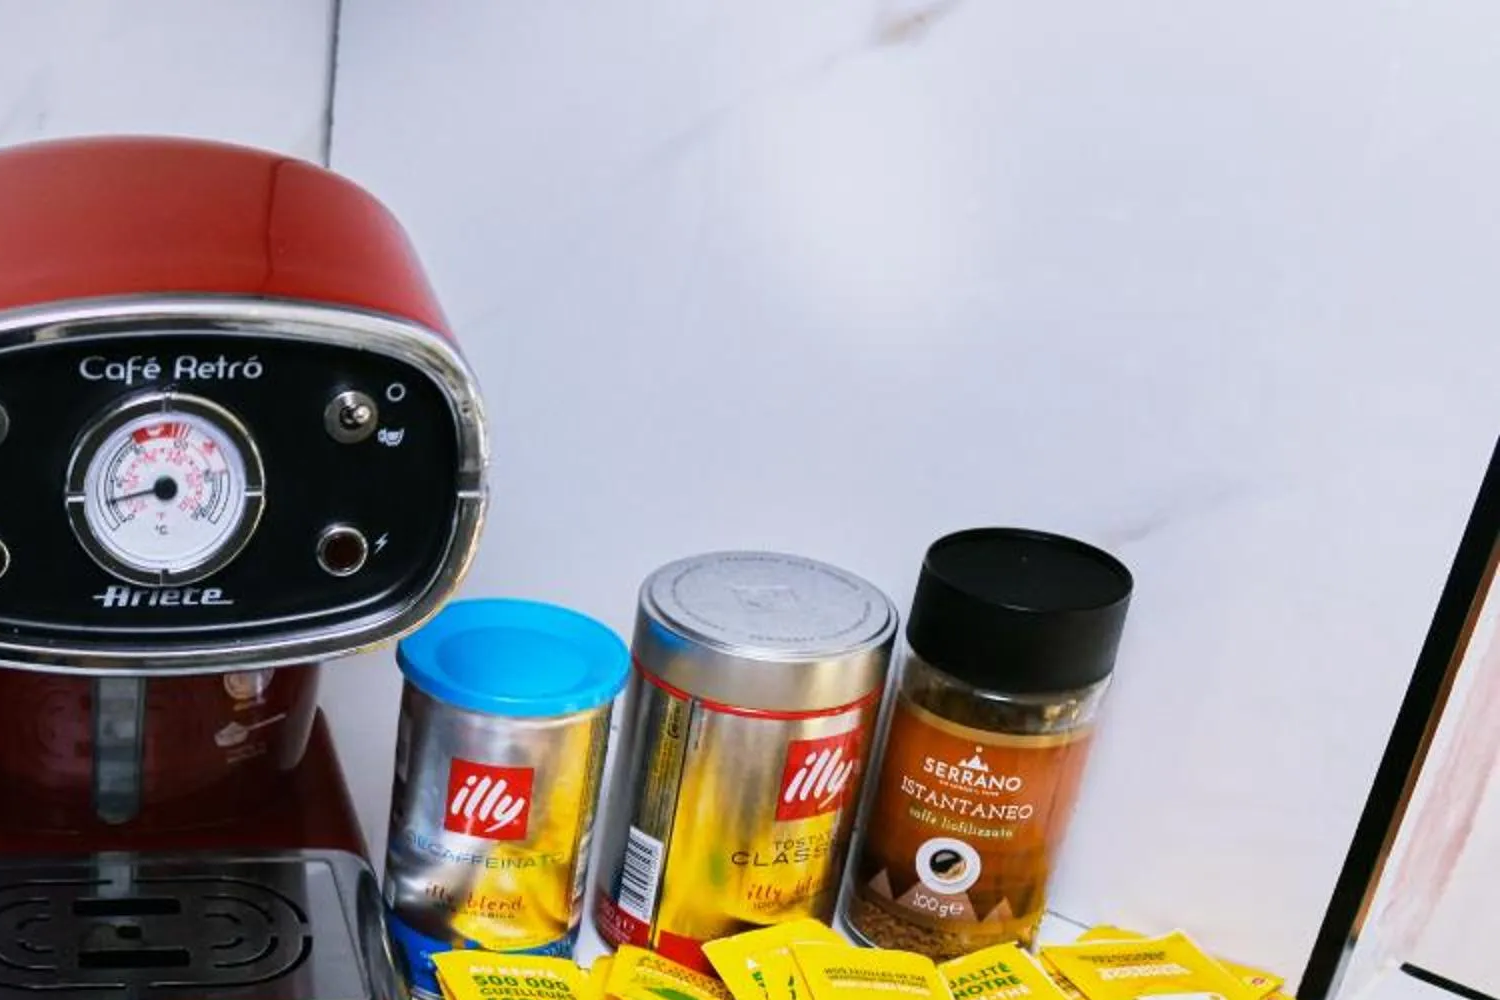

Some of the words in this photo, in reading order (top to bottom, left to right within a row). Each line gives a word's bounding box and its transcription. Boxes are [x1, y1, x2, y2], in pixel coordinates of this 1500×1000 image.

[79, 355, 161, 385] Café
[173, 354, 264, 379] Retró
[93, 585, 234, 607] Ariete
[784, 747, 853, 809] illy
[923, 757, 1022, 792] SERRANO
[451, 775, 526, 833] illy
[901, 775, 1033, 820] ISTANTANEO
